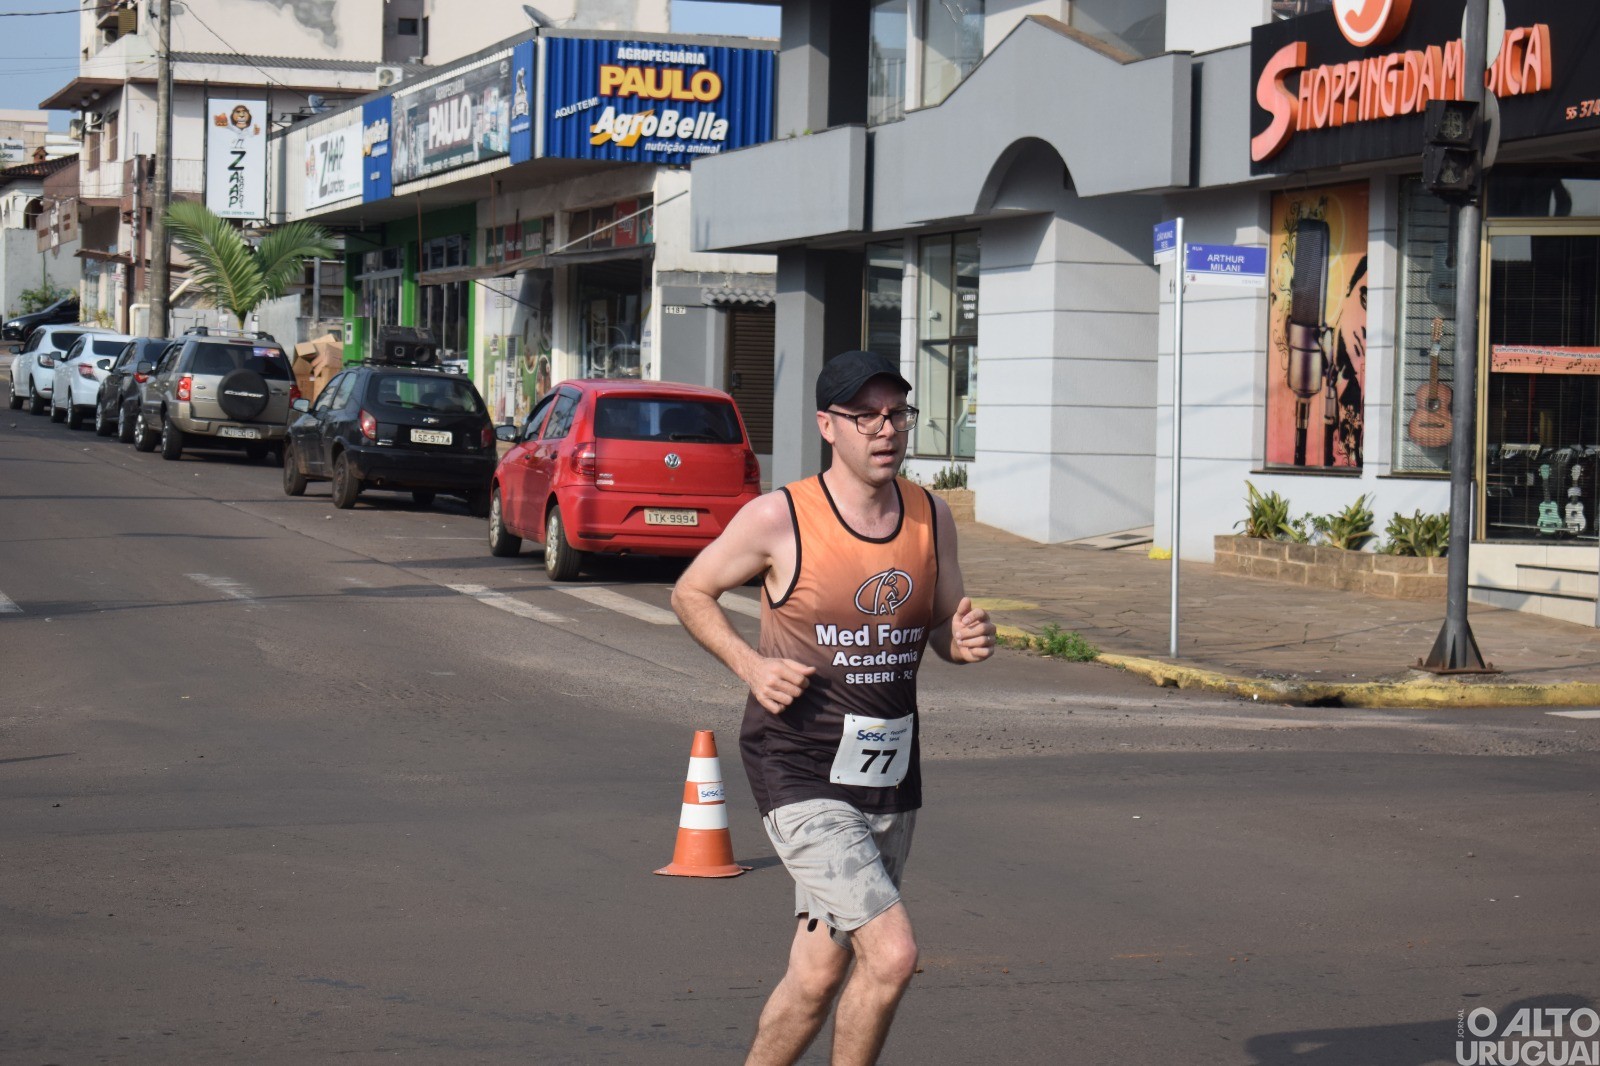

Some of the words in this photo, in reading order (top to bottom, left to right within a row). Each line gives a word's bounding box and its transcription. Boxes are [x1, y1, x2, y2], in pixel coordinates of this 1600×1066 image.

[617, 47, 706, 65] AGROPECUÁRIA
[1440, 23, 1552, 101] MICA
[600, 64, 722, 102] PAULO
[428, 94, 472, 149] PAULO
[1565, 106, 1578, 120] 55
[593, 106, 729, 142] AgroBella
[644, 142, 686, 155] nutrição
[686, 144, 721, 155] animal
[1207, 254, 1245, 264] ARTHUR
[1210, 263, 1241, 273] MILANI
[648, 513, 695, 523] ITK-9994
[815, 624, 870, 646] Med
[832, 651, 918, 667] Academia
[845, 671, 894, 684] SEBERI
[860, 749, 897, 774] 77
